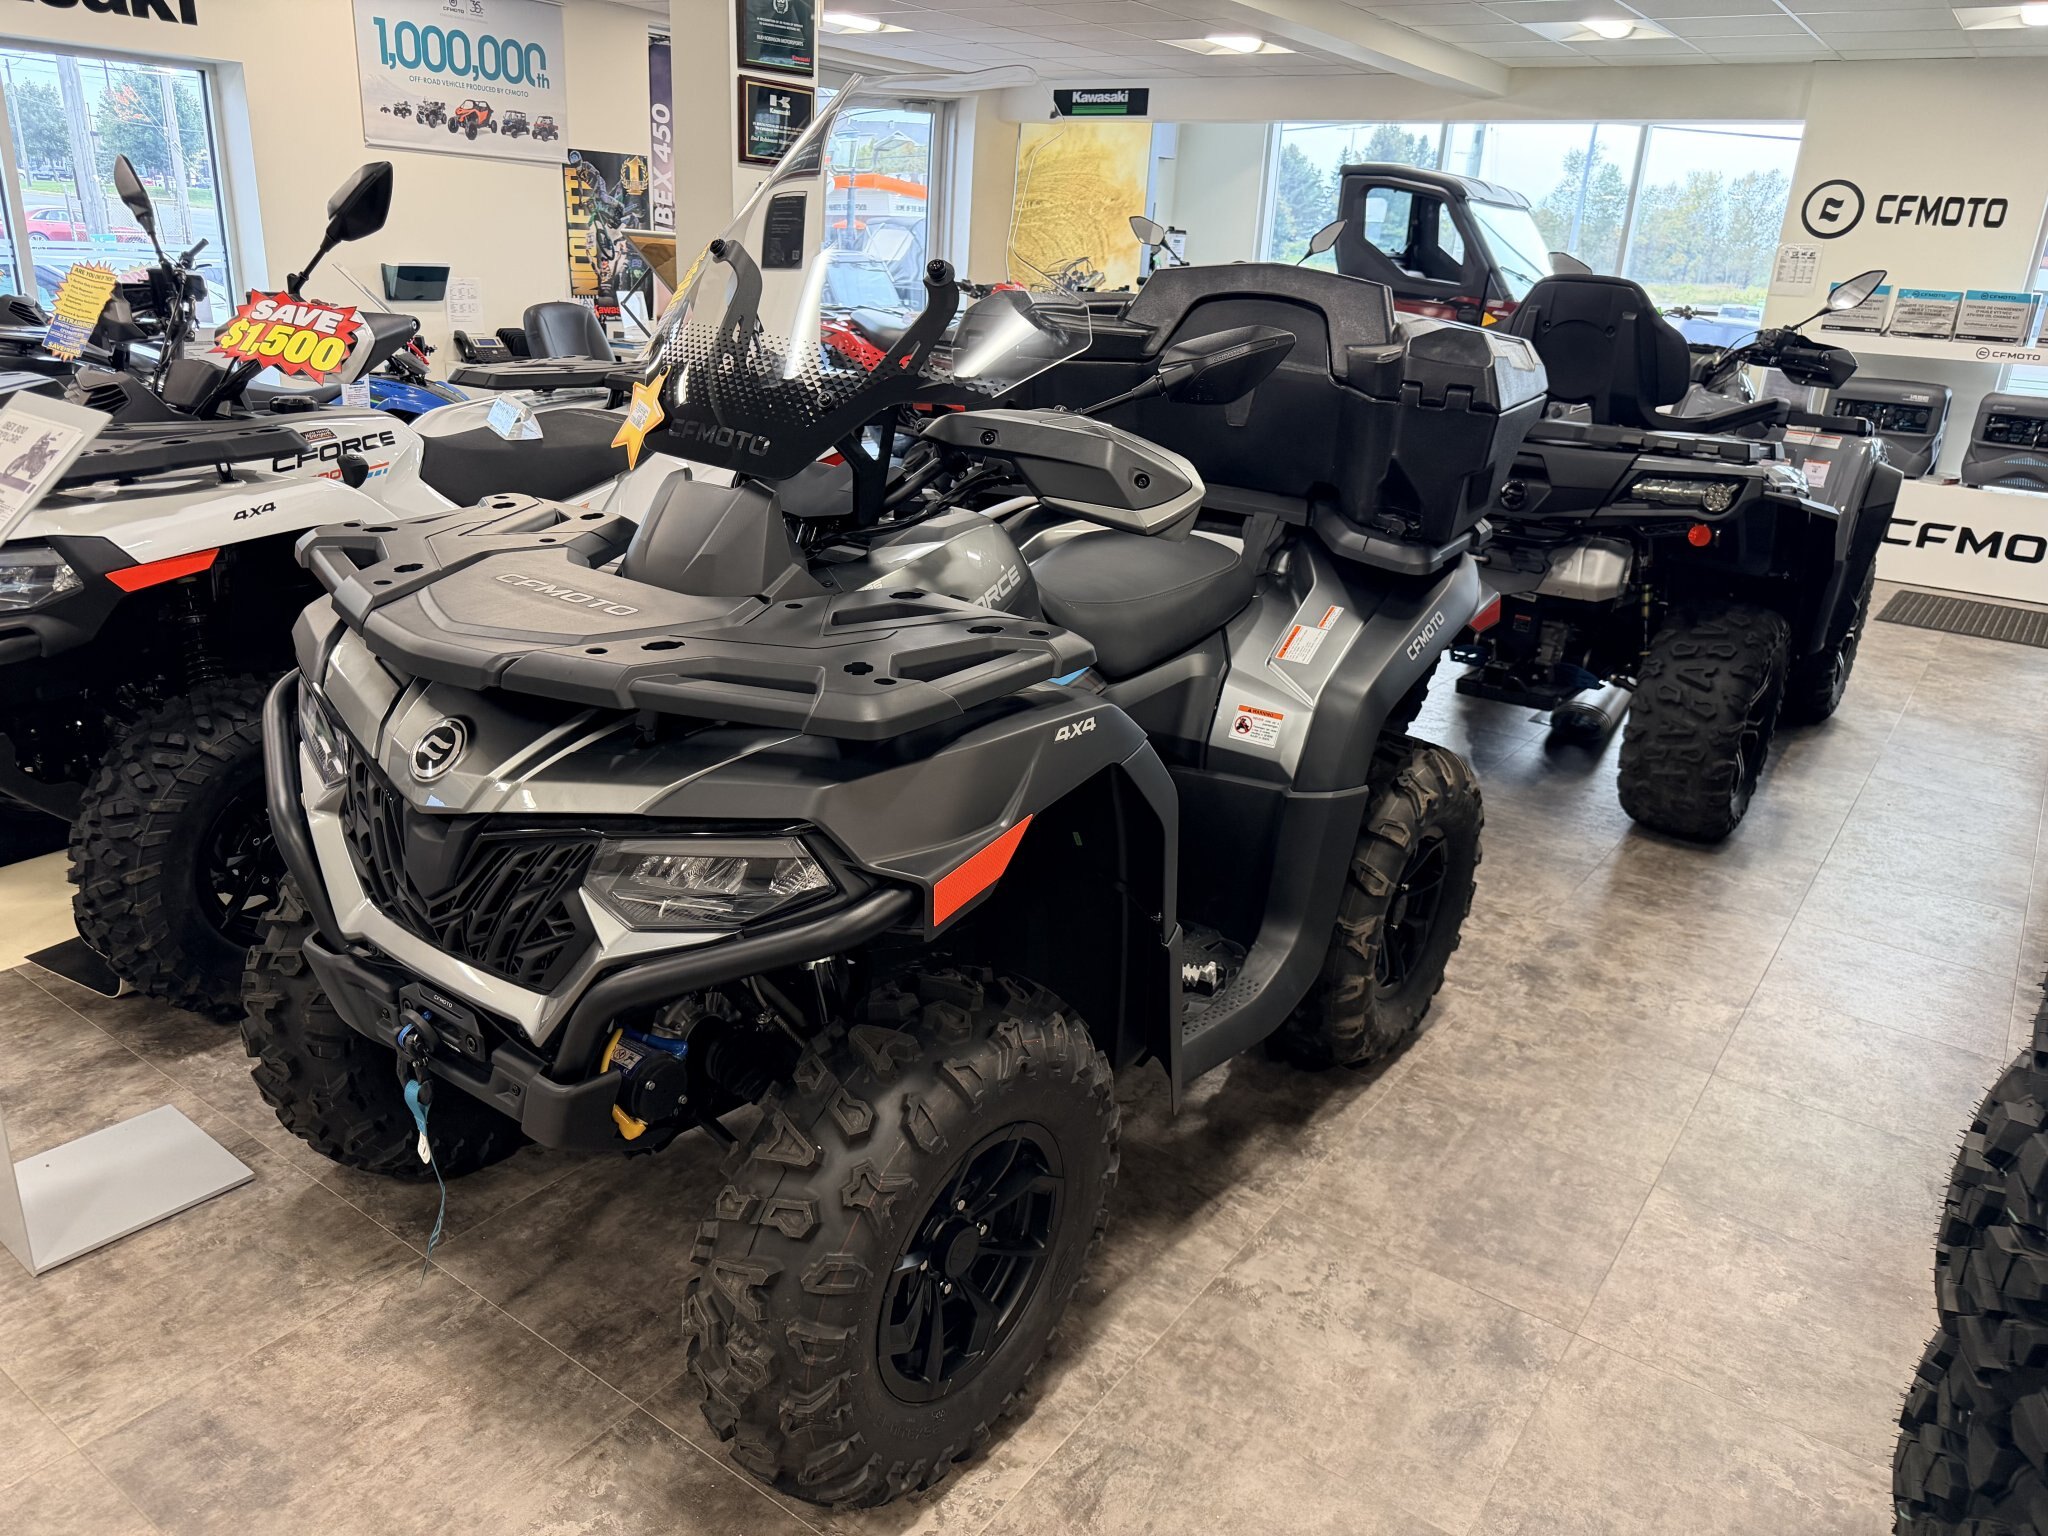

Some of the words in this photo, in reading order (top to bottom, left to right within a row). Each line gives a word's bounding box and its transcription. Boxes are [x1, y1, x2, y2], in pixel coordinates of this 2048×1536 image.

[409, 75, 441, 87] OFF-ROAD
[441, 79, 465, 90] VEHICLE
[466, 83, 496, 94] PRODUCED
[504, 88, 529, 98] CFMOTO
[1072, 90, 1129, 103] Kawasaki
[651, 103, 671, 163] 450
[653, 166, 675, 232] IBEX
[1875, 194, 2009, 229] CFMOTO
[250, 299, 345, 335] SAVE
[220, 317, 347, 372] $1,500
[1992, 351, 2041, 361] CFMOTO
[272, 430, 396, 473] CFORCE
[668, 418, 771, 456] CFMOTO
[1881, 517, 2048, 564] CFMO
[495, 573, 639, 616] CFMOTO
[1406, 611, 1445, 661] CFMOTO
[433, 994, 453, 1008] CFMOTO
